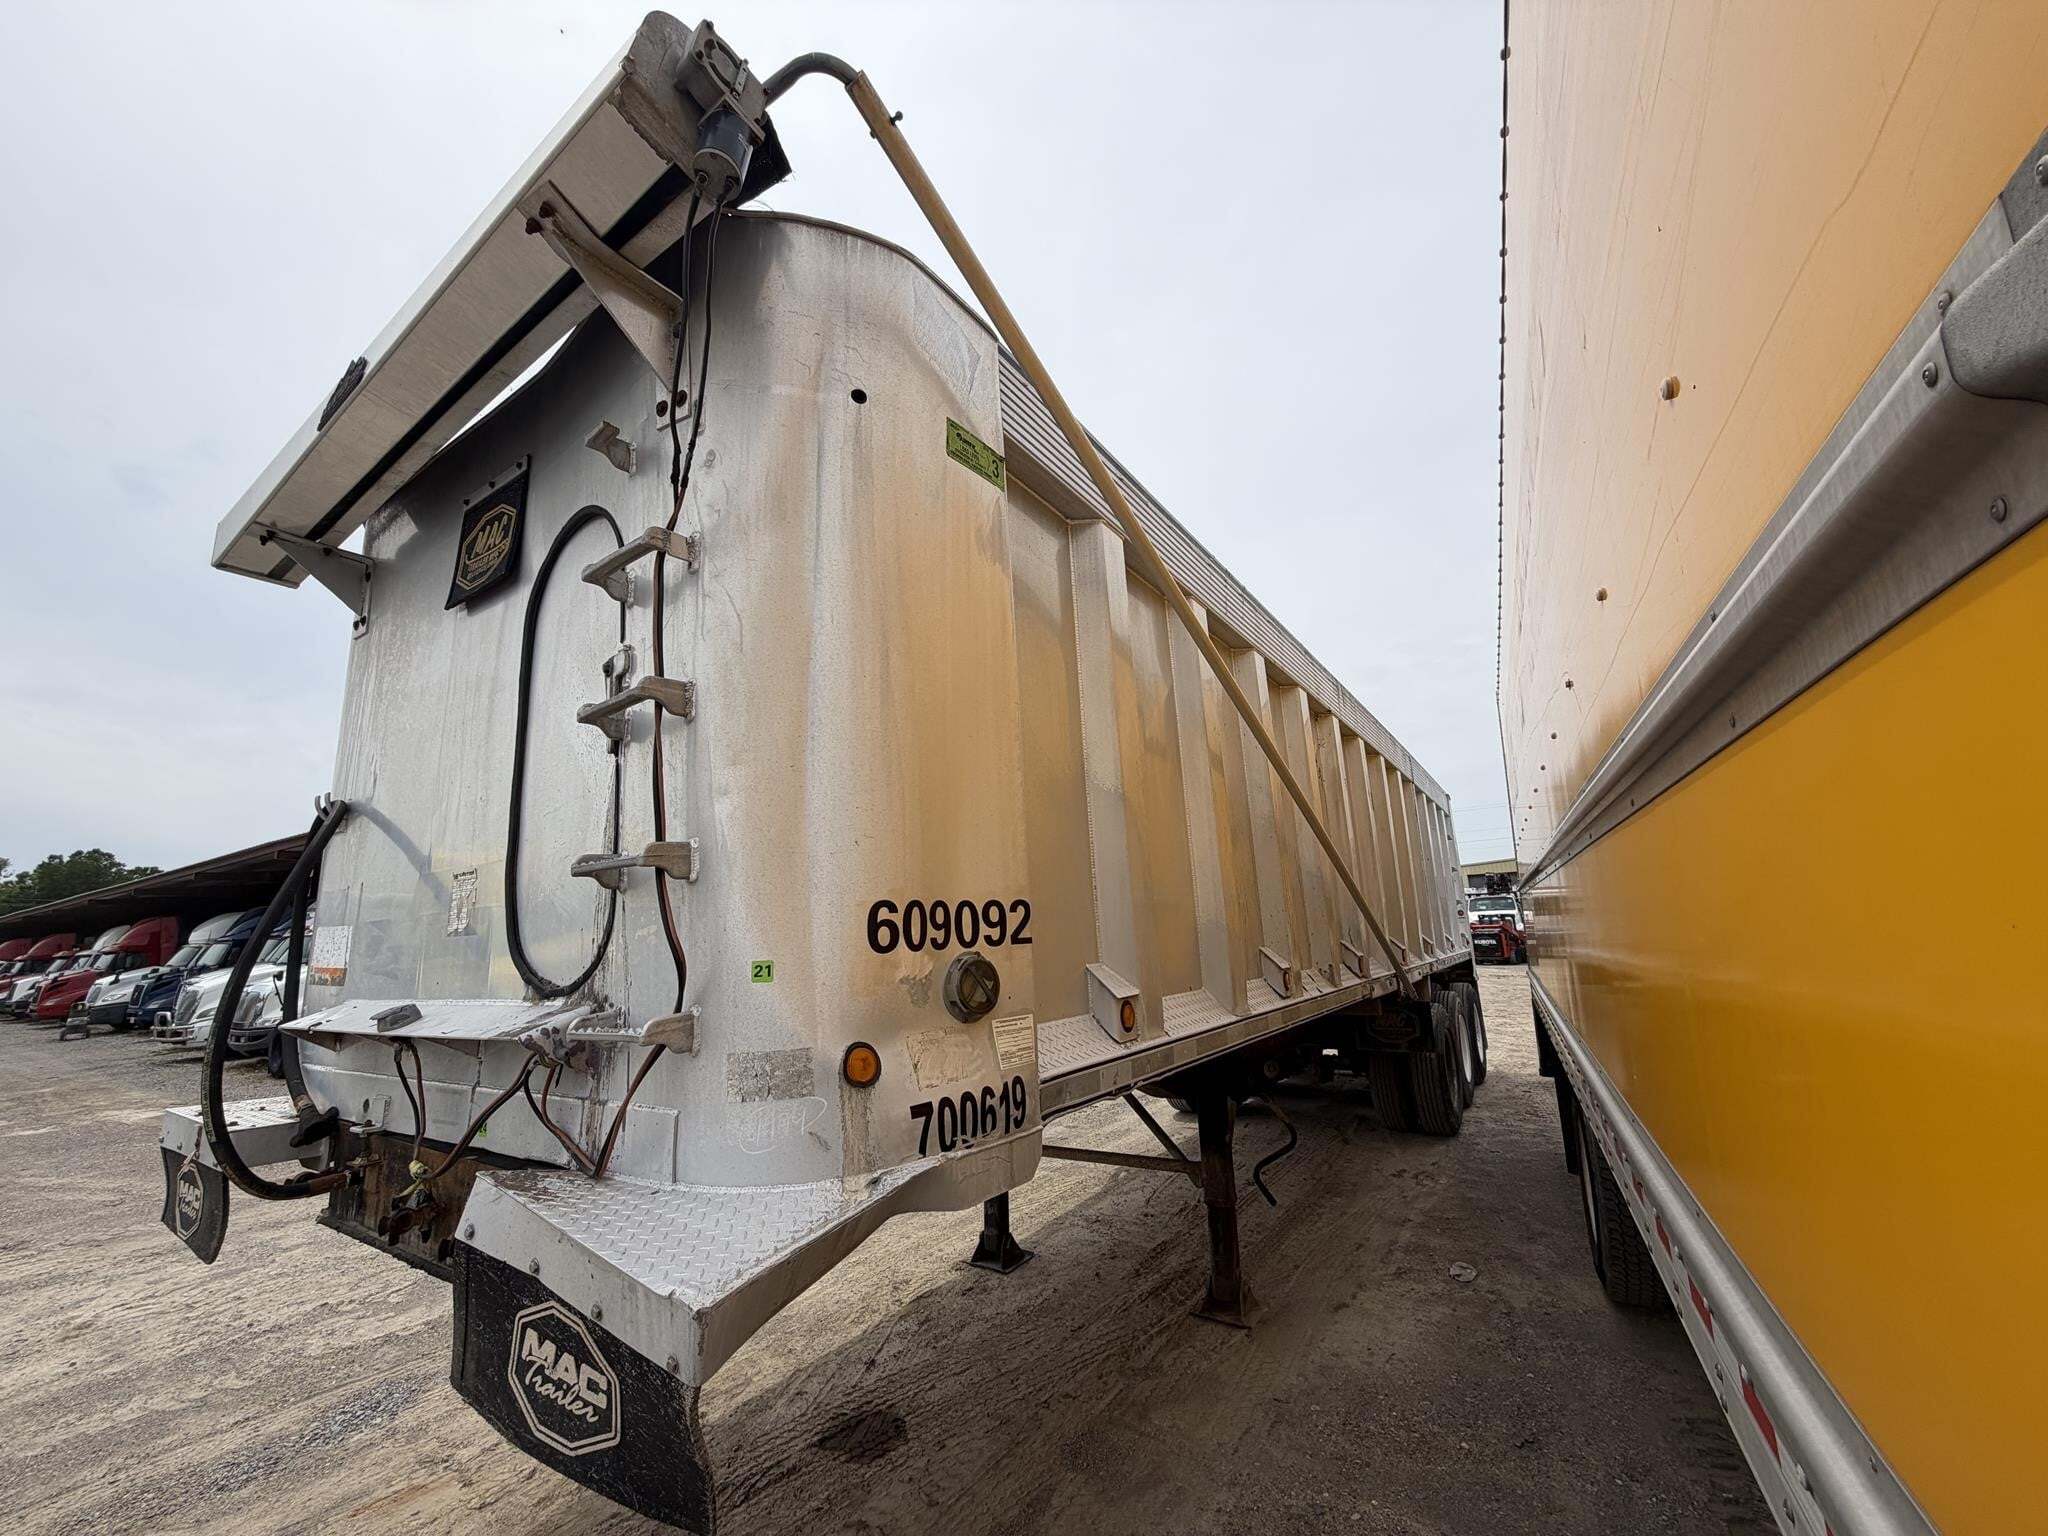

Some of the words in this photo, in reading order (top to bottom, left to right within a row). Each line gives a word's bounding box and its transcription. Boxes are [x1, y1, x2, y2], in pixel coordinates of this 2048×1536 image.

[991, 459, 999, 479] 3
[471, 514, 508, 559] MAC
[867, 899, 1033, 954] 609092
[754, 964, 771, 978] 21
[909, 1075, 1027, 1157] 700619
[521, 1327, 608, 1410] MAC
[525, 1354, 599, 1423] Trailer
